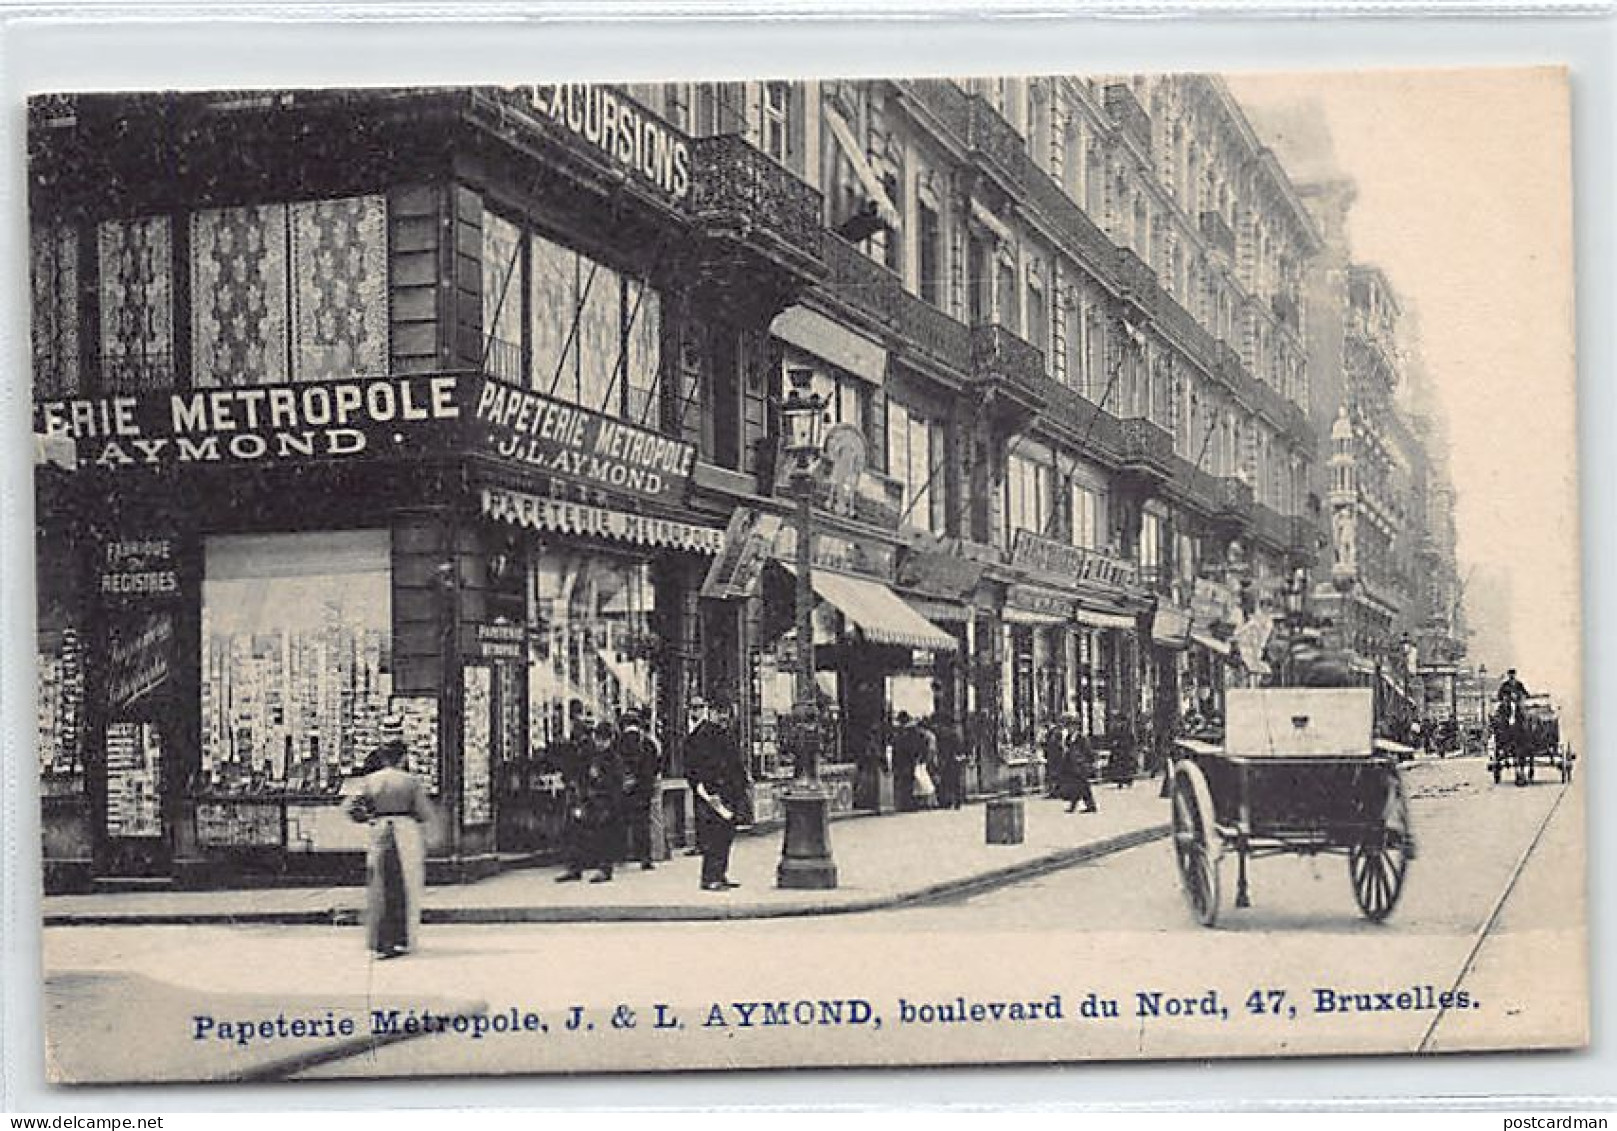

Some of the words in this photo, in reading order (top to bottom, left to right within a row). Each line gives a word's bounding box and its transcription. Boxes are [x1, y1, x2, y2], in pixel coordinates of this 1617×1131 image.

[33, 397, 140, 438] ERIE
[171, 377, 459, 433] METROPOLE
[477, 380, 590, 447] PAPETERIE
[594, 420, 695, 477] METROPOLE
[96, 429, 367, 464] AYMOND
